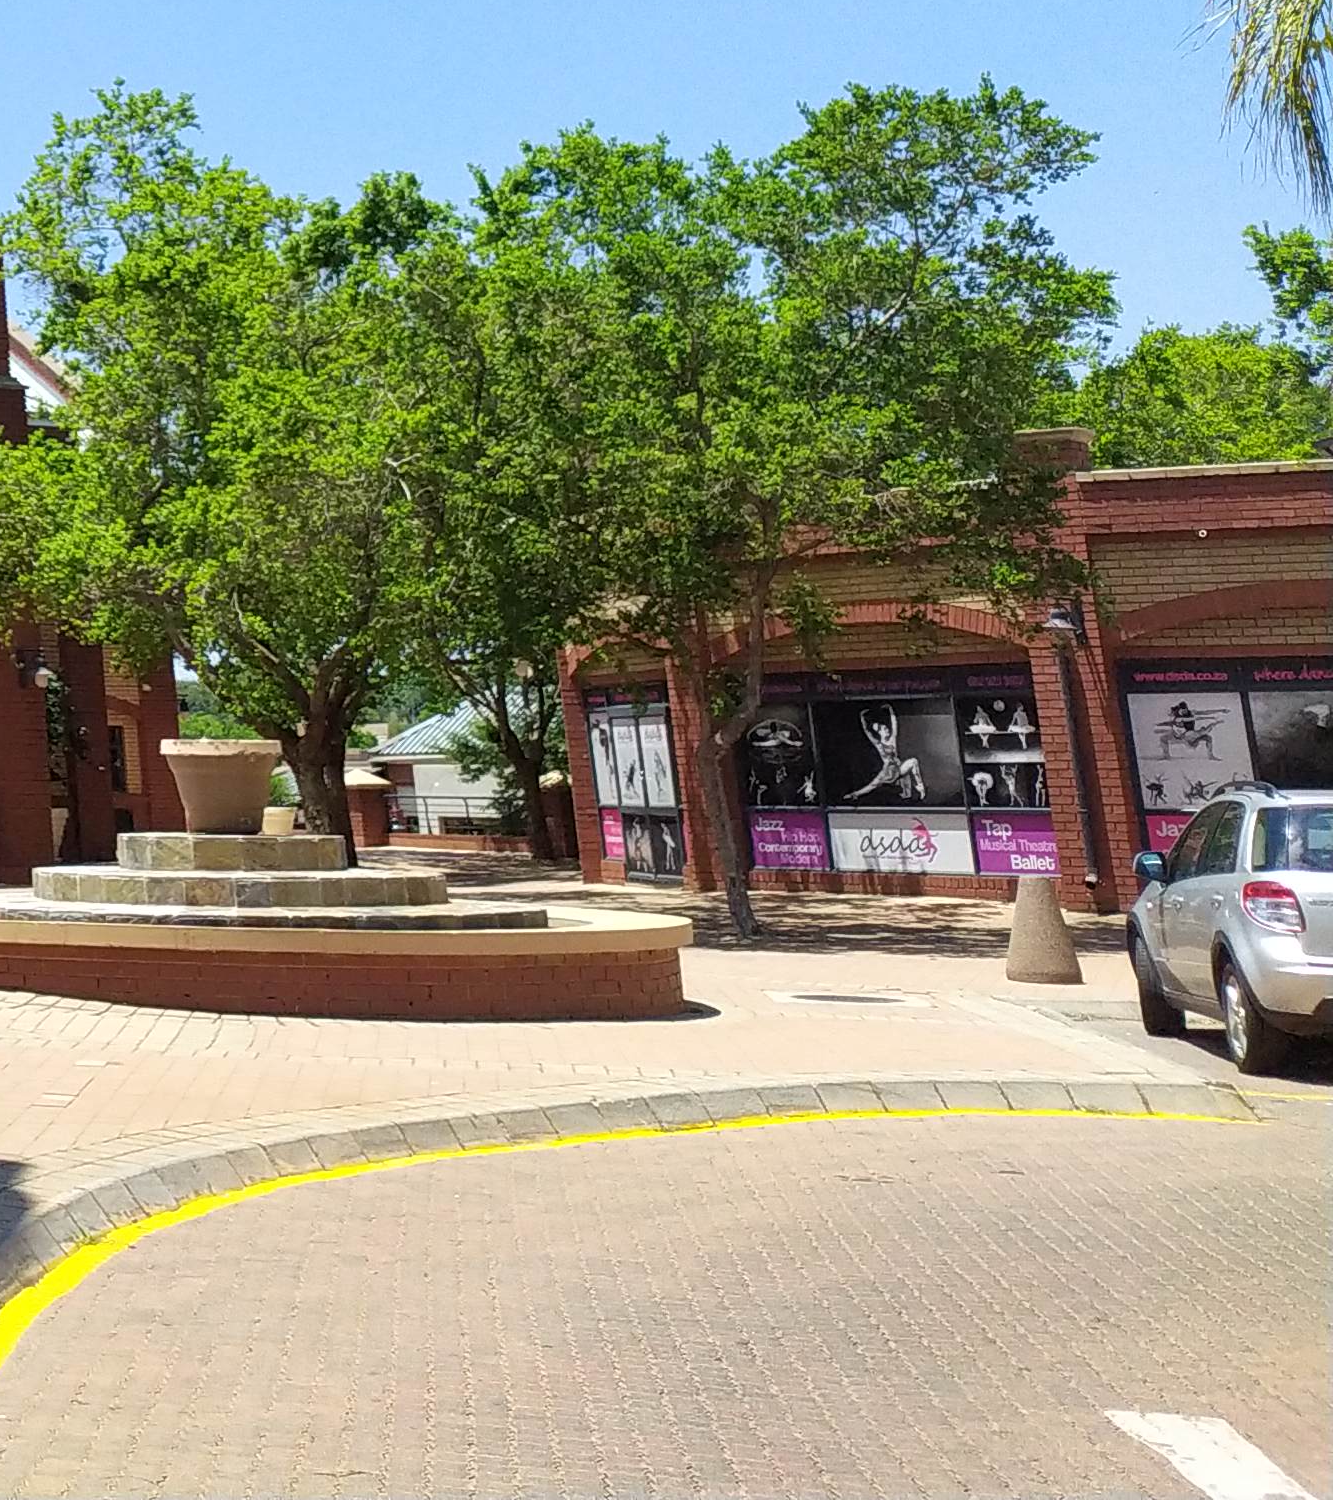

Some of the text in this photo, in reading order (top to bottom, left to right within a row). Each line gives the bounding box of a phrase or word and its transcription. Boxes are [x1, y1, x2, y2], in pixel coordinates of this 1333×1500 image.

[755, 817, 785, 832] Jazz
[981, 819, 1012, 841] Tap
[758, 842, 822, 856] Contemporary
[859, 829, 926, 854] dsda
[979, 838, 1016, 852] Musical
[1010, 854, 1056, 871] Ballet
